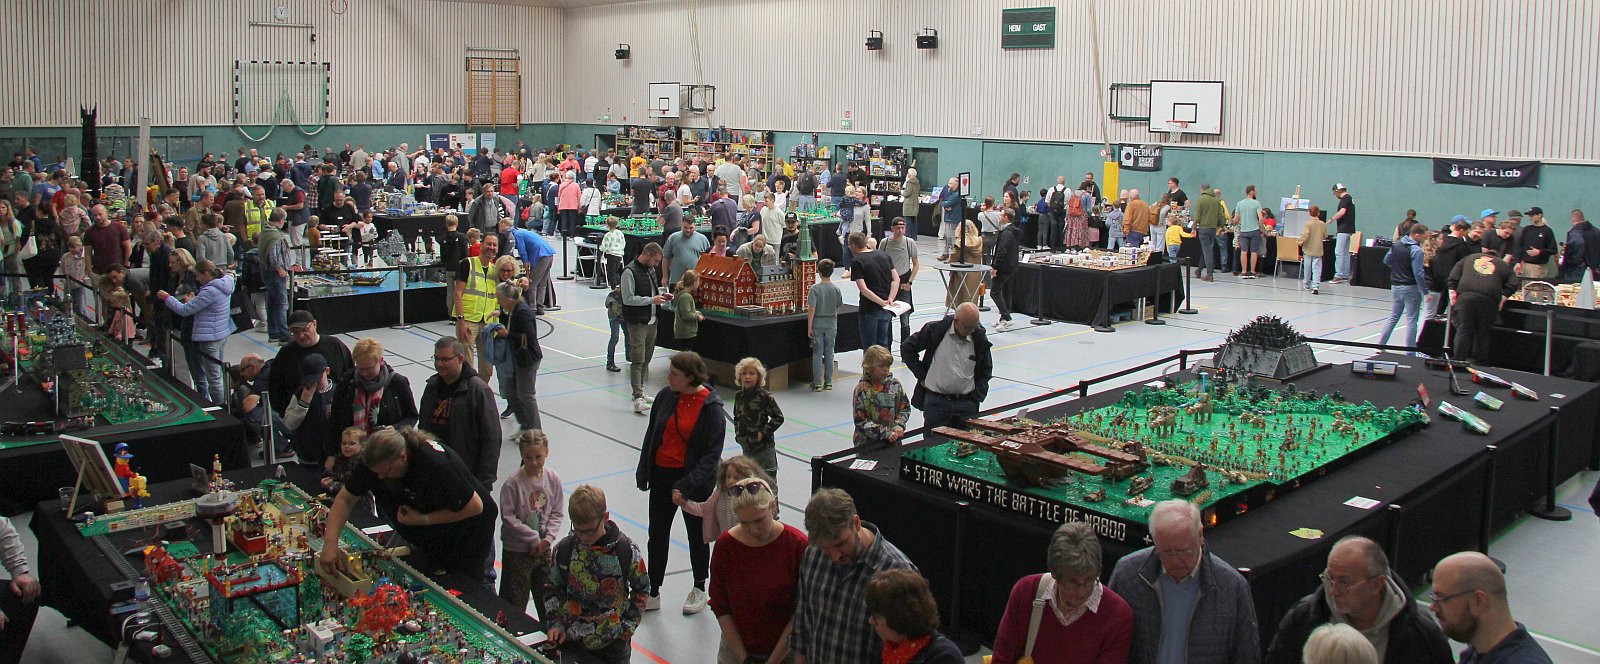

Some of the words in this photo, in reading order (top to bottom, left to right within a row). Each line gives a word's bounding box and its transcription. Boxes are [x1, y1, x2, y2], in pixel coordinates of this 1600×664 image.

[1008, 24, 1021, 32] HEIM
[1032, 23, 1046, 31] GAST
[1133, 148, 1159, 157] GERMAN
[1463, 167, 1498, 177] Brickz
[1500, 168, 1521, 177] Lab
[914, 464, 942, 488] STAR
[946, 473, 981, 500] WARS
[986, 485, 1008, 508] THE
[1012, 493, 1060, 523] BATTLE
[1064, 507, 1080, 523] OF
